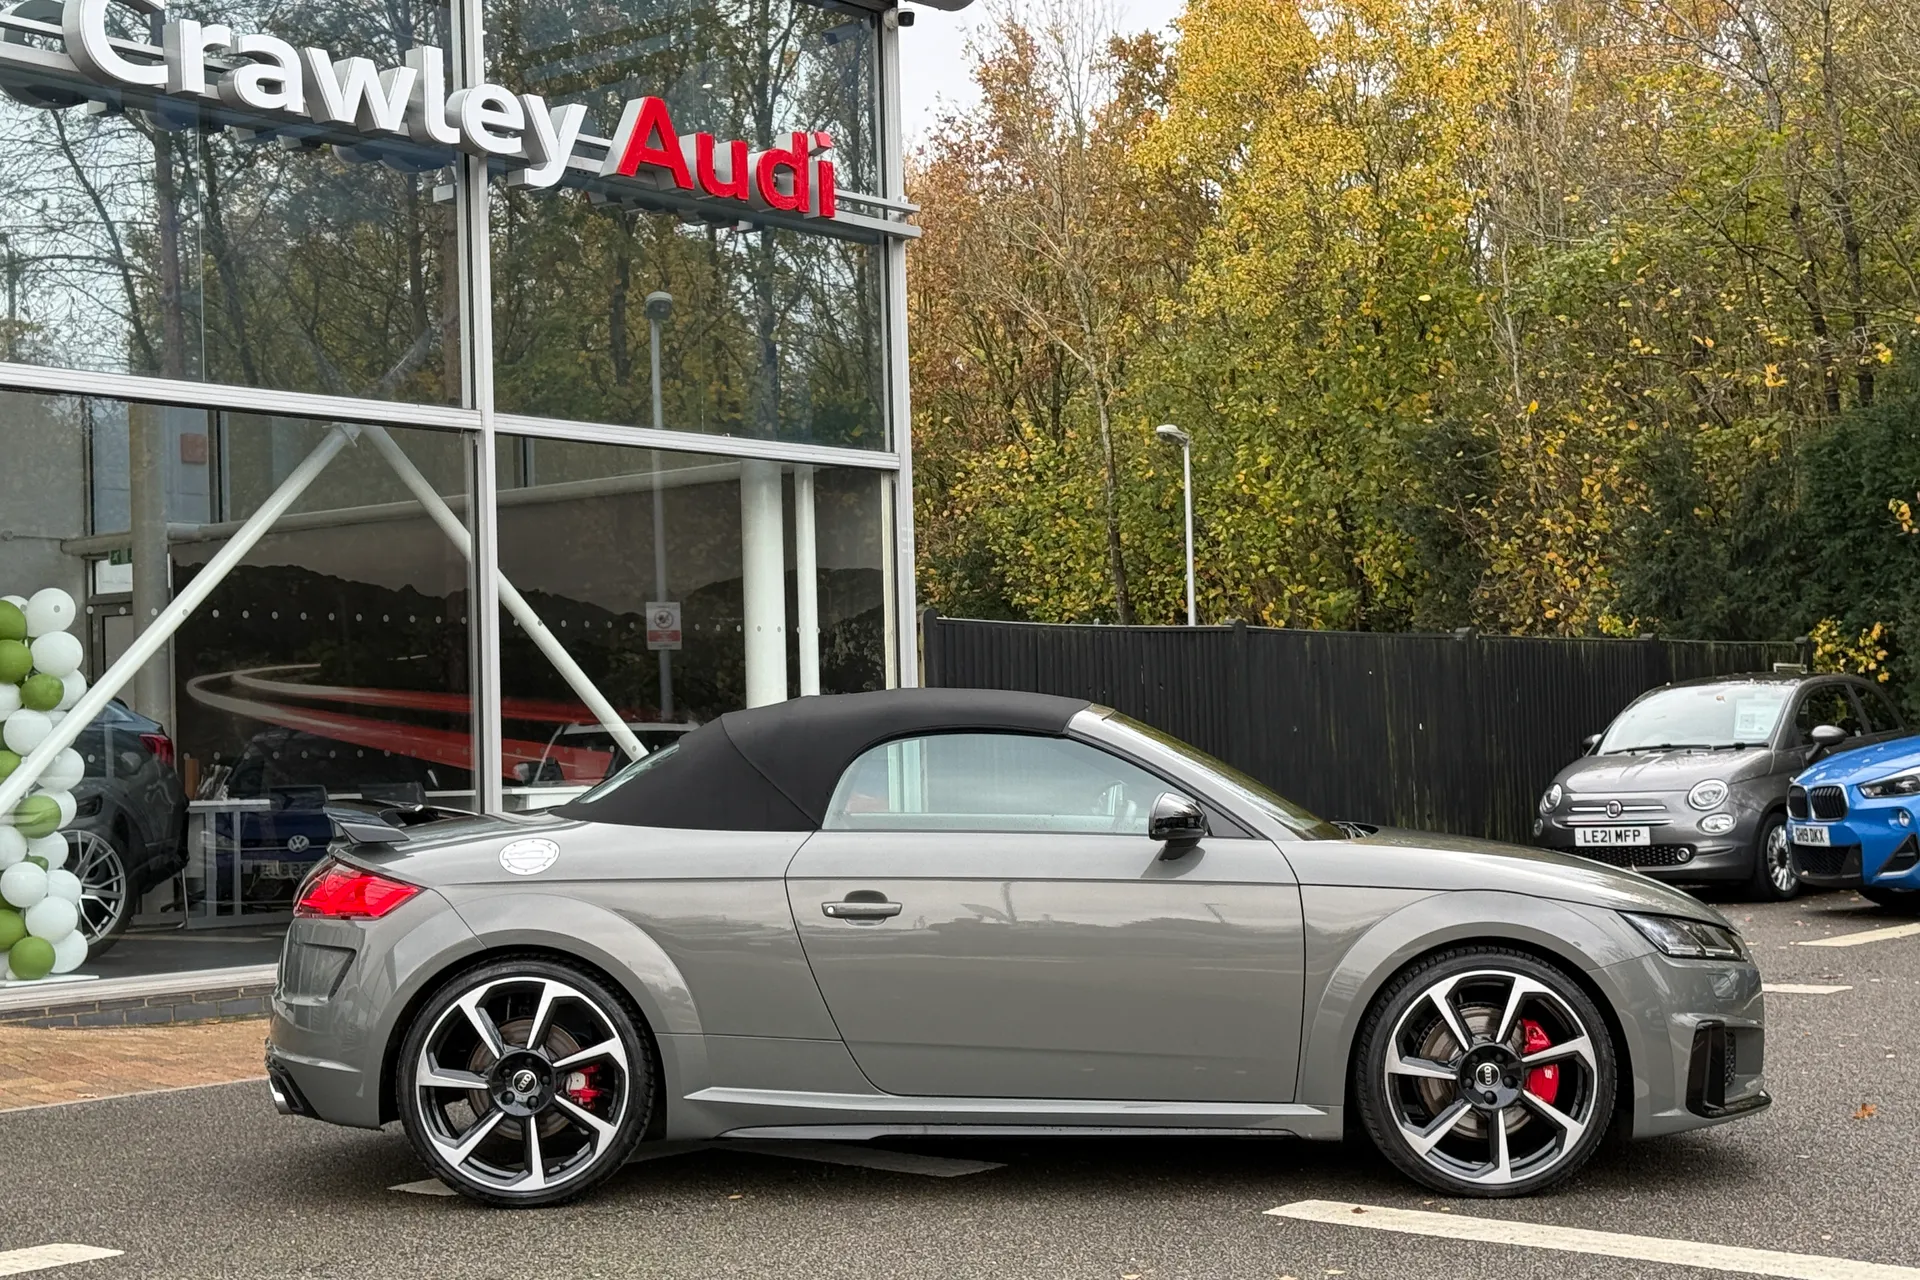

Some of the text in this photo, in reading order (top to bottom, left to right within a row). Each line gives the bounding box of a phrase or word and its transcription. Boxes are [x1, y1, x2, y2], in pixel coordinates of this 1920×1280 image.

[63, 0, 836, 219] Crawley Audi
[1583, 829, 1641, 844] LE21 MFP
